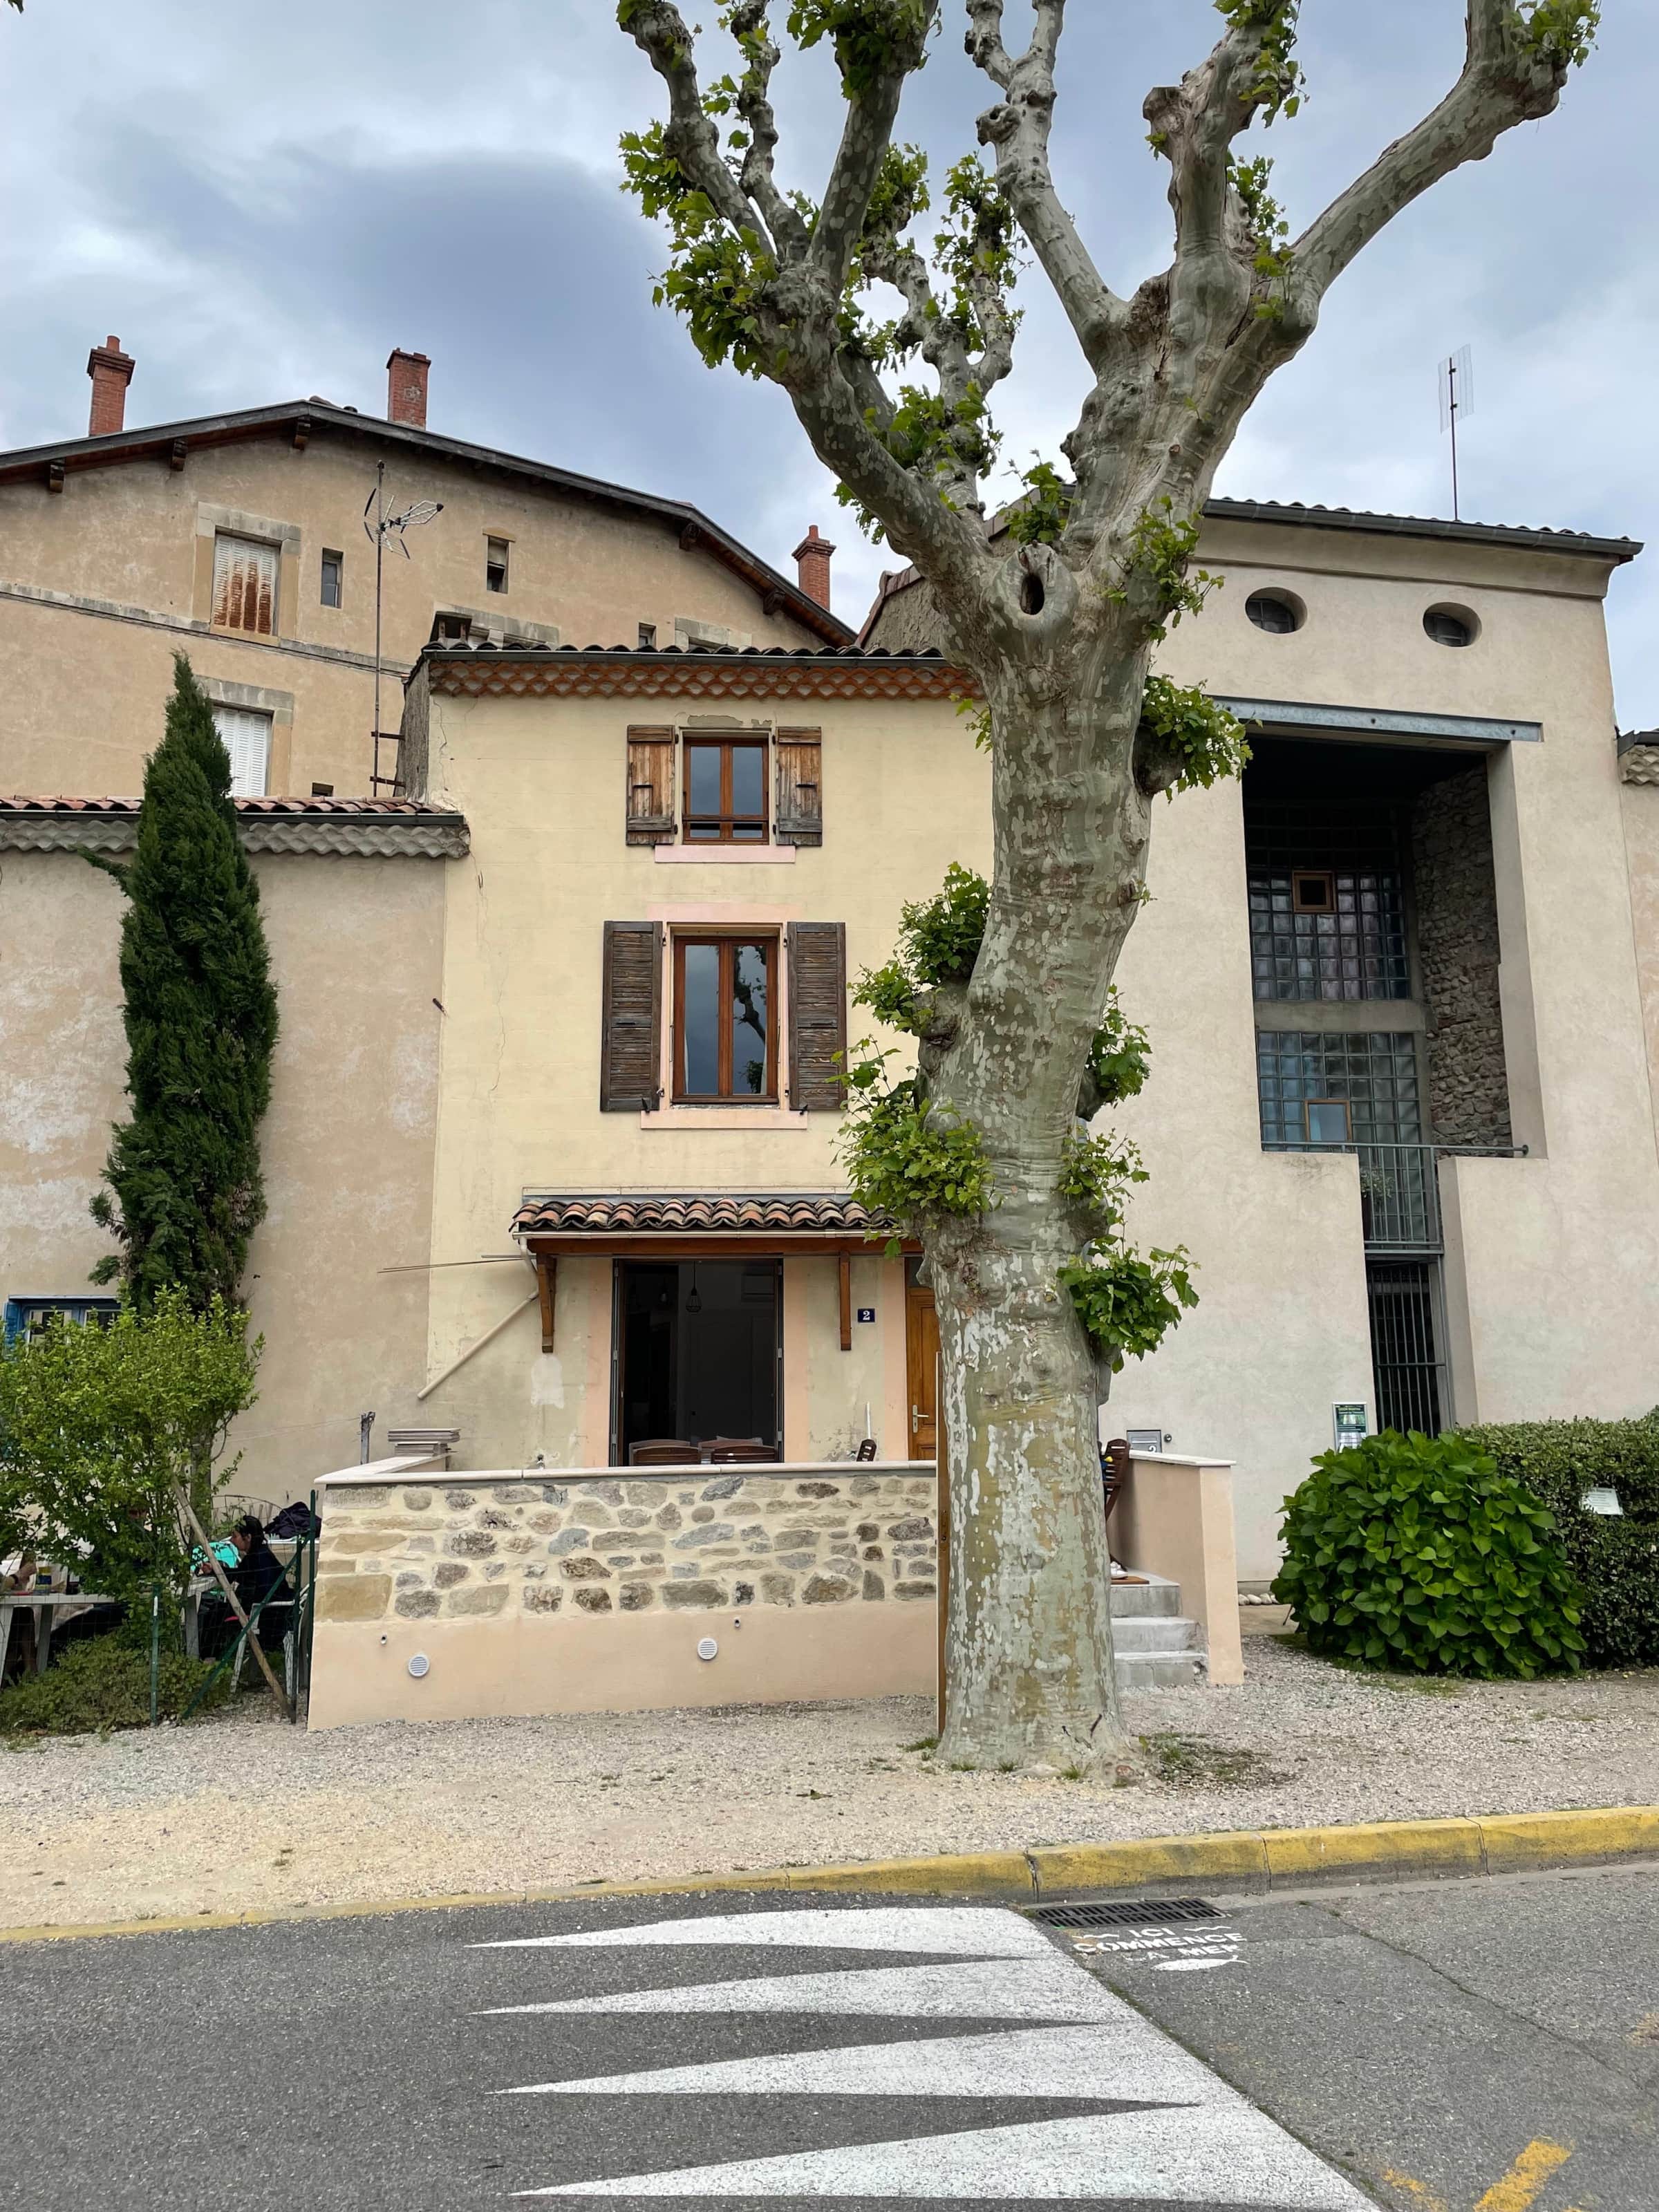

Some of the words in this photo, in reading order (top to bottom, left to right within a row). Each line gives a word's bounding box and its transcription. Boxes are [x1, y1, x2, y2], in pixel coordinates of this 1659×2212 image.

[863, 1310, 870, 1320] 2
[1128, 1927, 1176, 1938] ICI
[1073, 1933, 1247, 1952] COMMENCE
[1122, 1951, 1170, 1961] LA
[1177, 1944, 1244, 1956] MER
